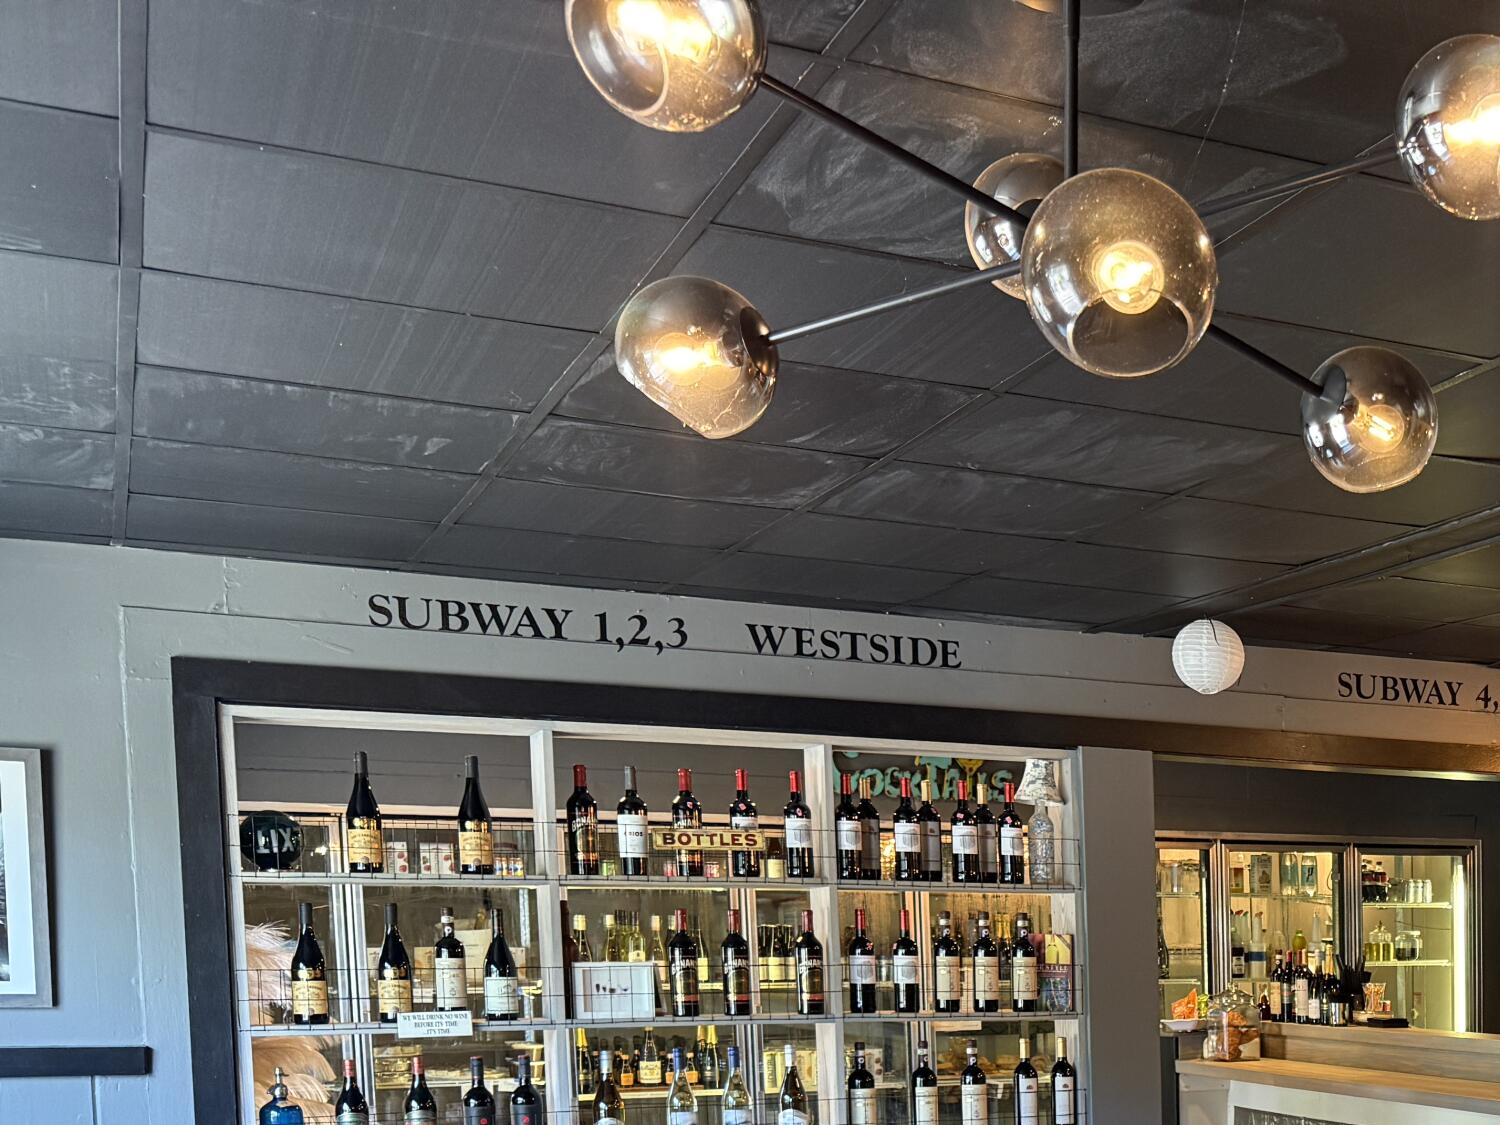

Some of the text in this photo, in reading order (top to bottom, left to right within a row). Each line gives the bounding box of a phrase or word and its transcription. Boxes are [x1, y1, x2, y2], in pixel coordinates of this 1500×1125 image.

[367, 594, 963, 669] SUBWAY 1,2,3 WESTSIDE
[1337, 671, 1463, 706] SUBWAY
[663, 832, 758, 847] BOTTLES
